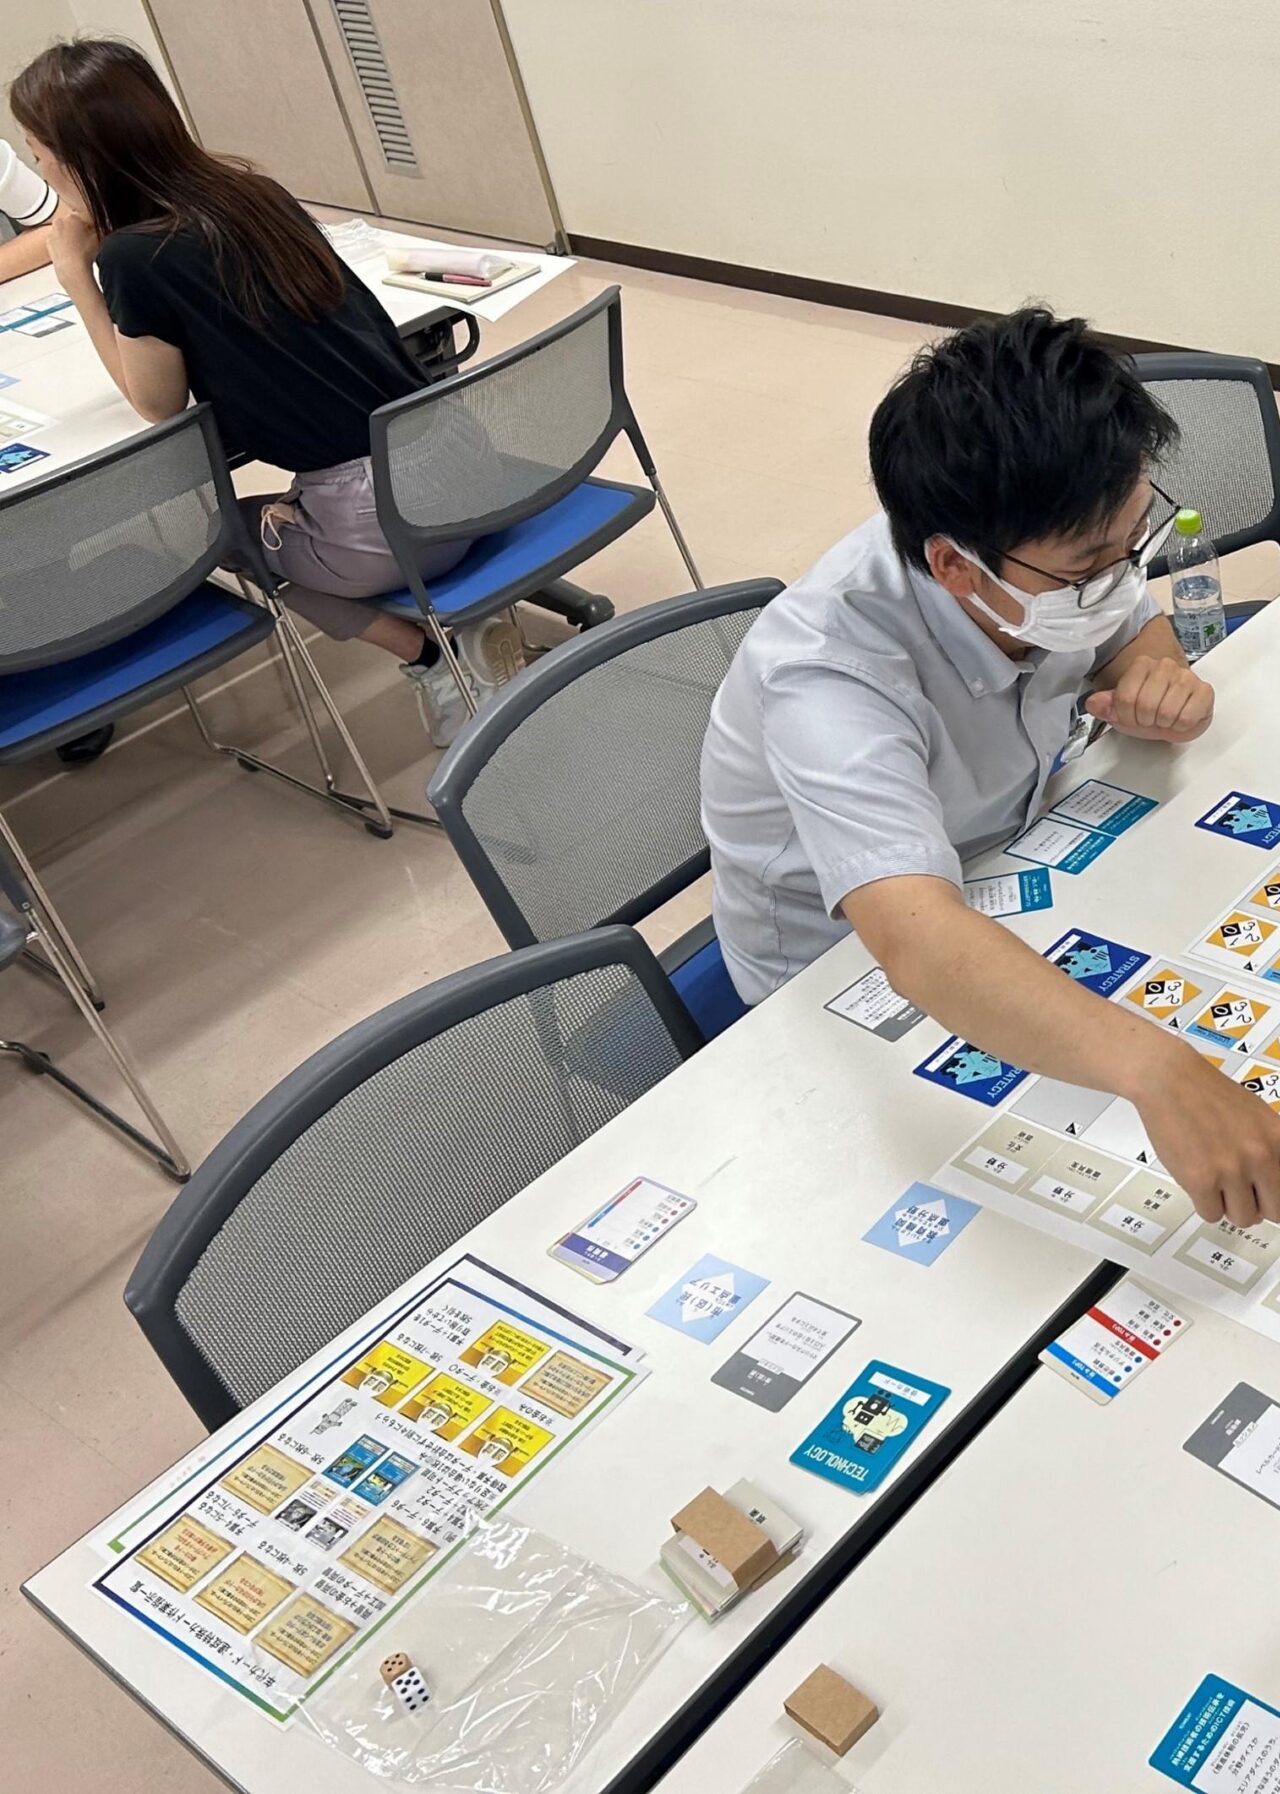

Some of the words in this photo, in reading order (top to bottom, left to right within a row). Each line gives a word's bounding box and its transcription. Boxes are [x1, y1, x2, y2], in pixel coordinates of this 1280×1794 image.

[1097, 954, 1140, 992] STRATEGY
[1148, 983, 1161, 992] 0
[1167, 982, 1182, 991] 3
[1165, 994, 1180, 1004] 2
[1234, 1001, 1248, 1012] 3
[1214, 1006, 1228, 1015] 0
[1236, 1014, 1252, 1023] 2
[986, 1066, 1022, 1098] RATEGY
[985, 1155, 1008, 1170] 分野
[1051, 1184, 1075, 1199] 分野
[907, 1204, 950, 1228] 重点分野
[1122, 1214, 1145, 1229] 分野
[1210, 1250, 1235, 1267] 分野
[689, 1276, 741, 1306] 重点エリア
[804, 1442, 869, 1482] TECHNOLOGY
